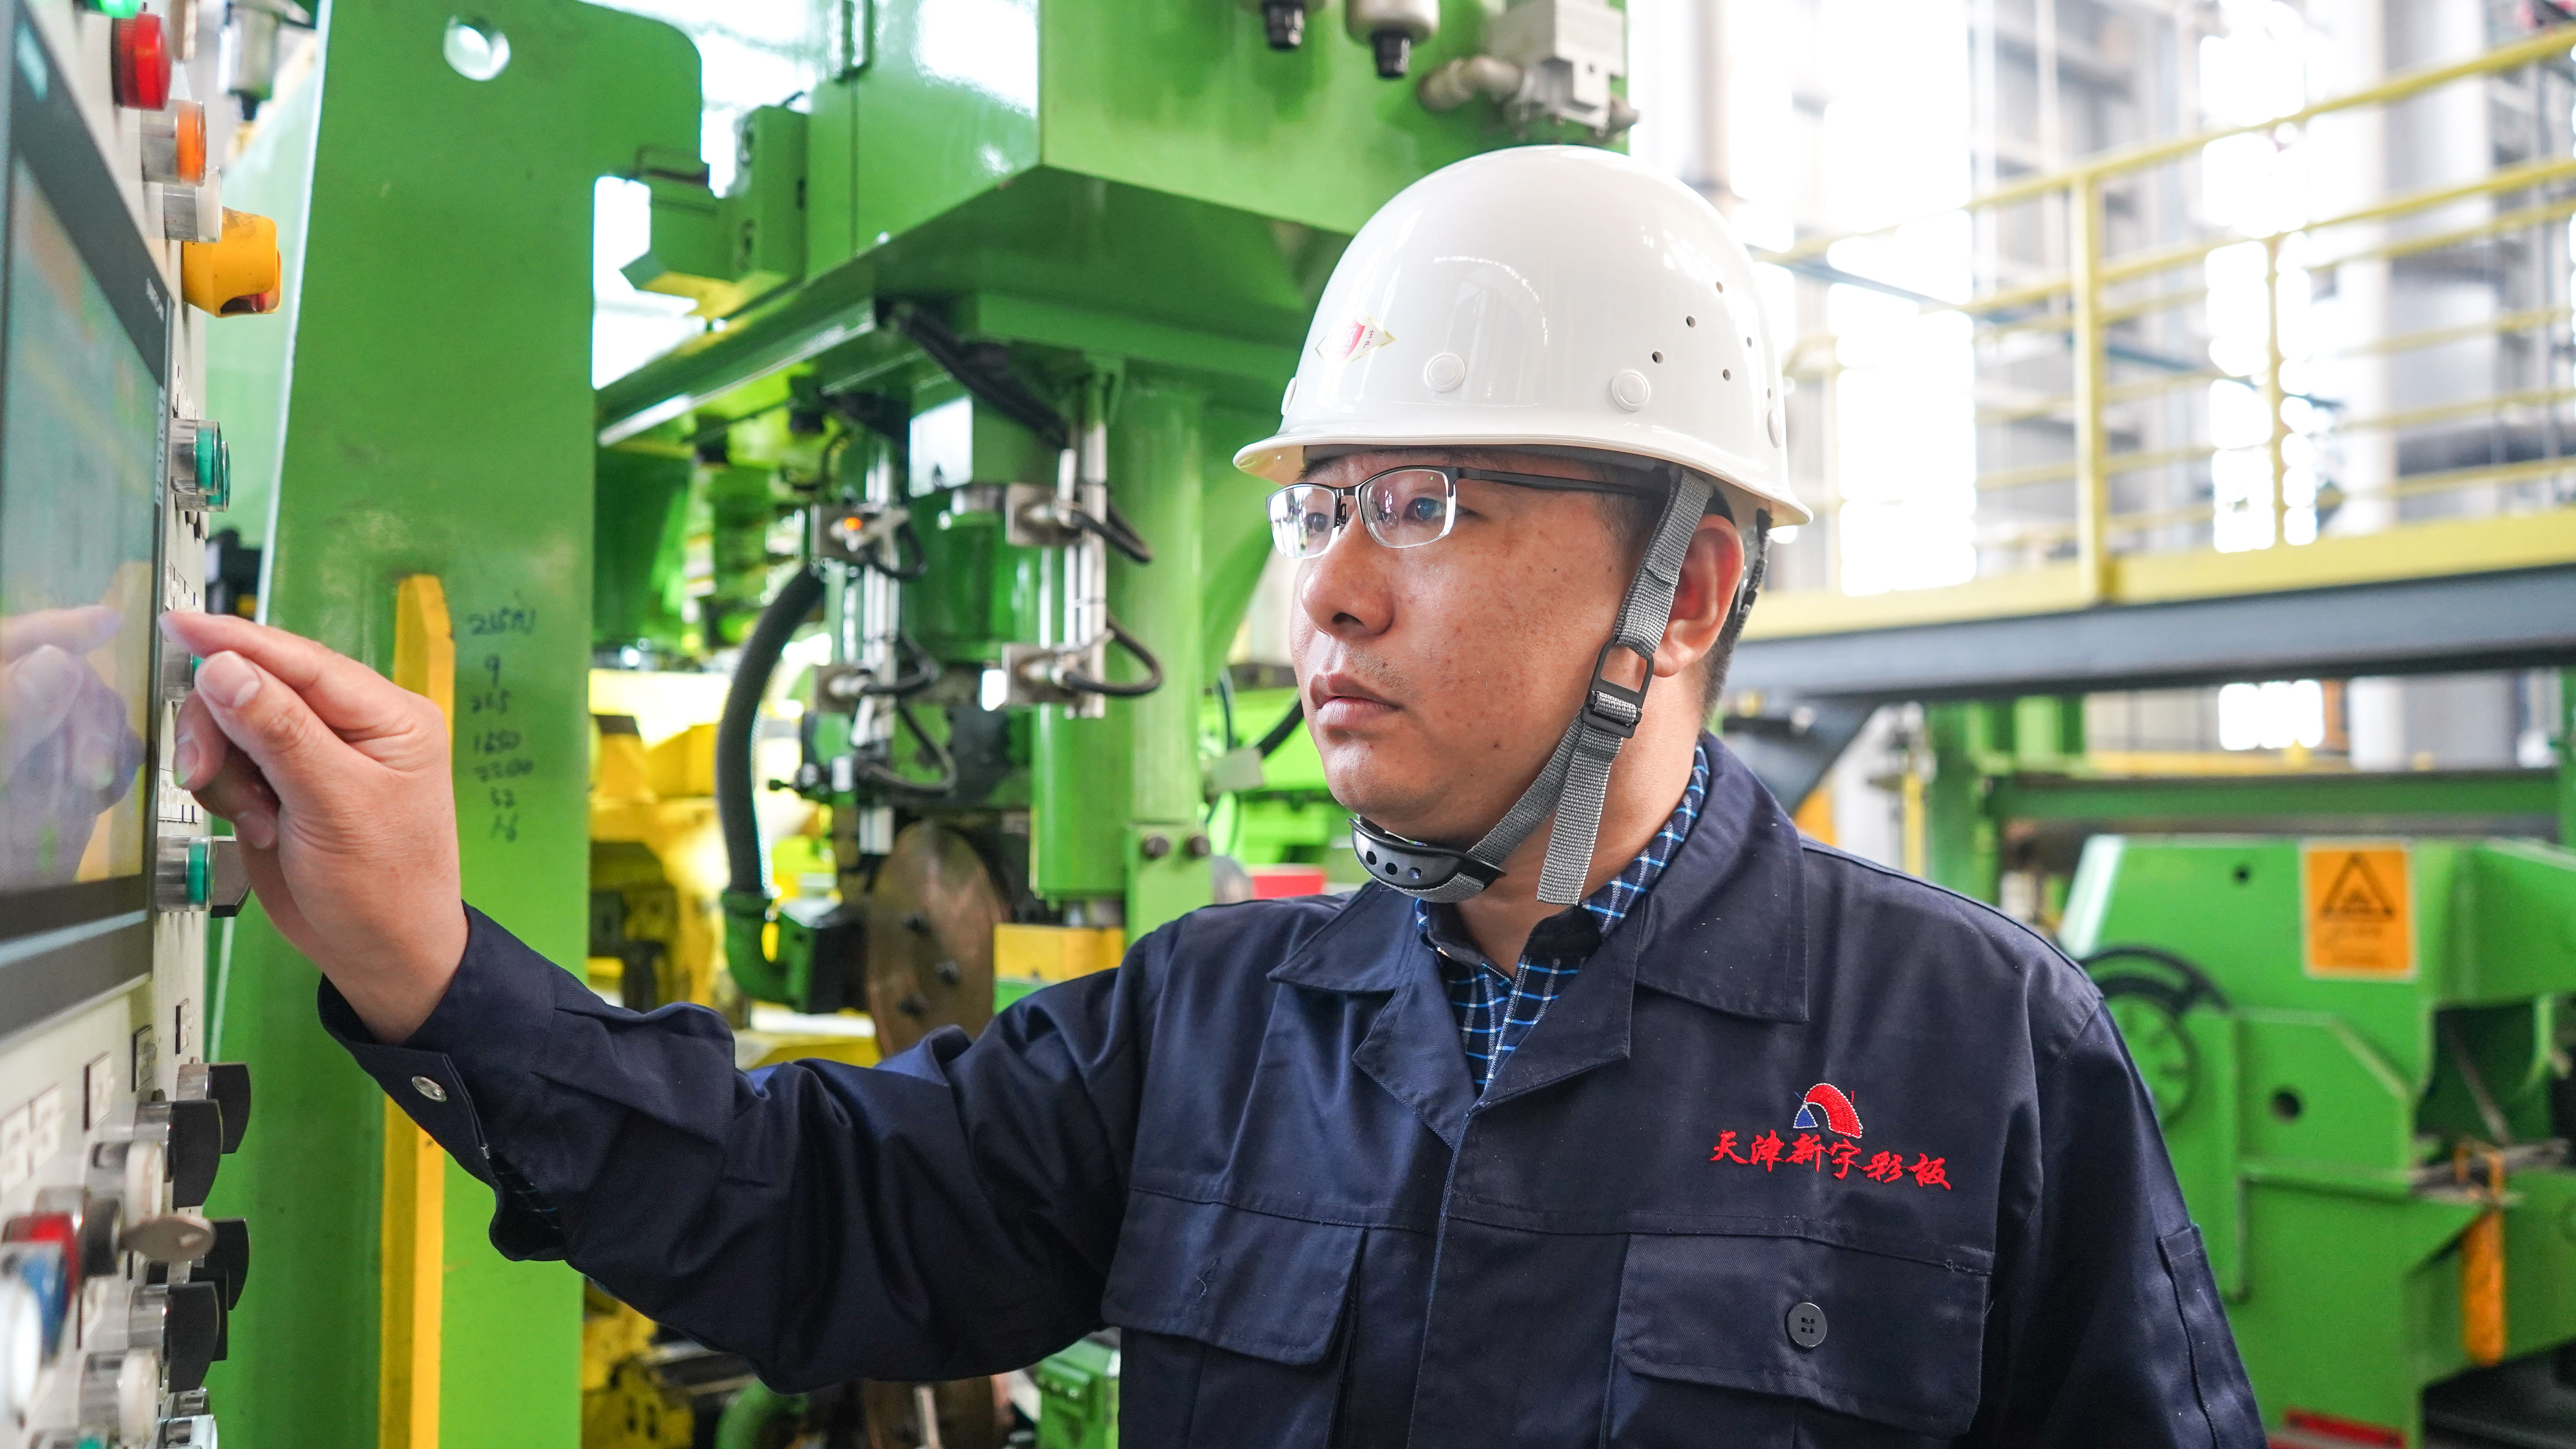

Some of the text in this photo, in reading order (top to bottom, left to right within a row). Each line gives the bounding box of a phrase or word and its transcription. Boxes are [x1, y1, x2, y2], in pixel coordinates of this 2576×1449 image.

[1363, 329, 1374, 349] 生产
[1710, 1129, 1951, 1190] 天津新宇彩板
